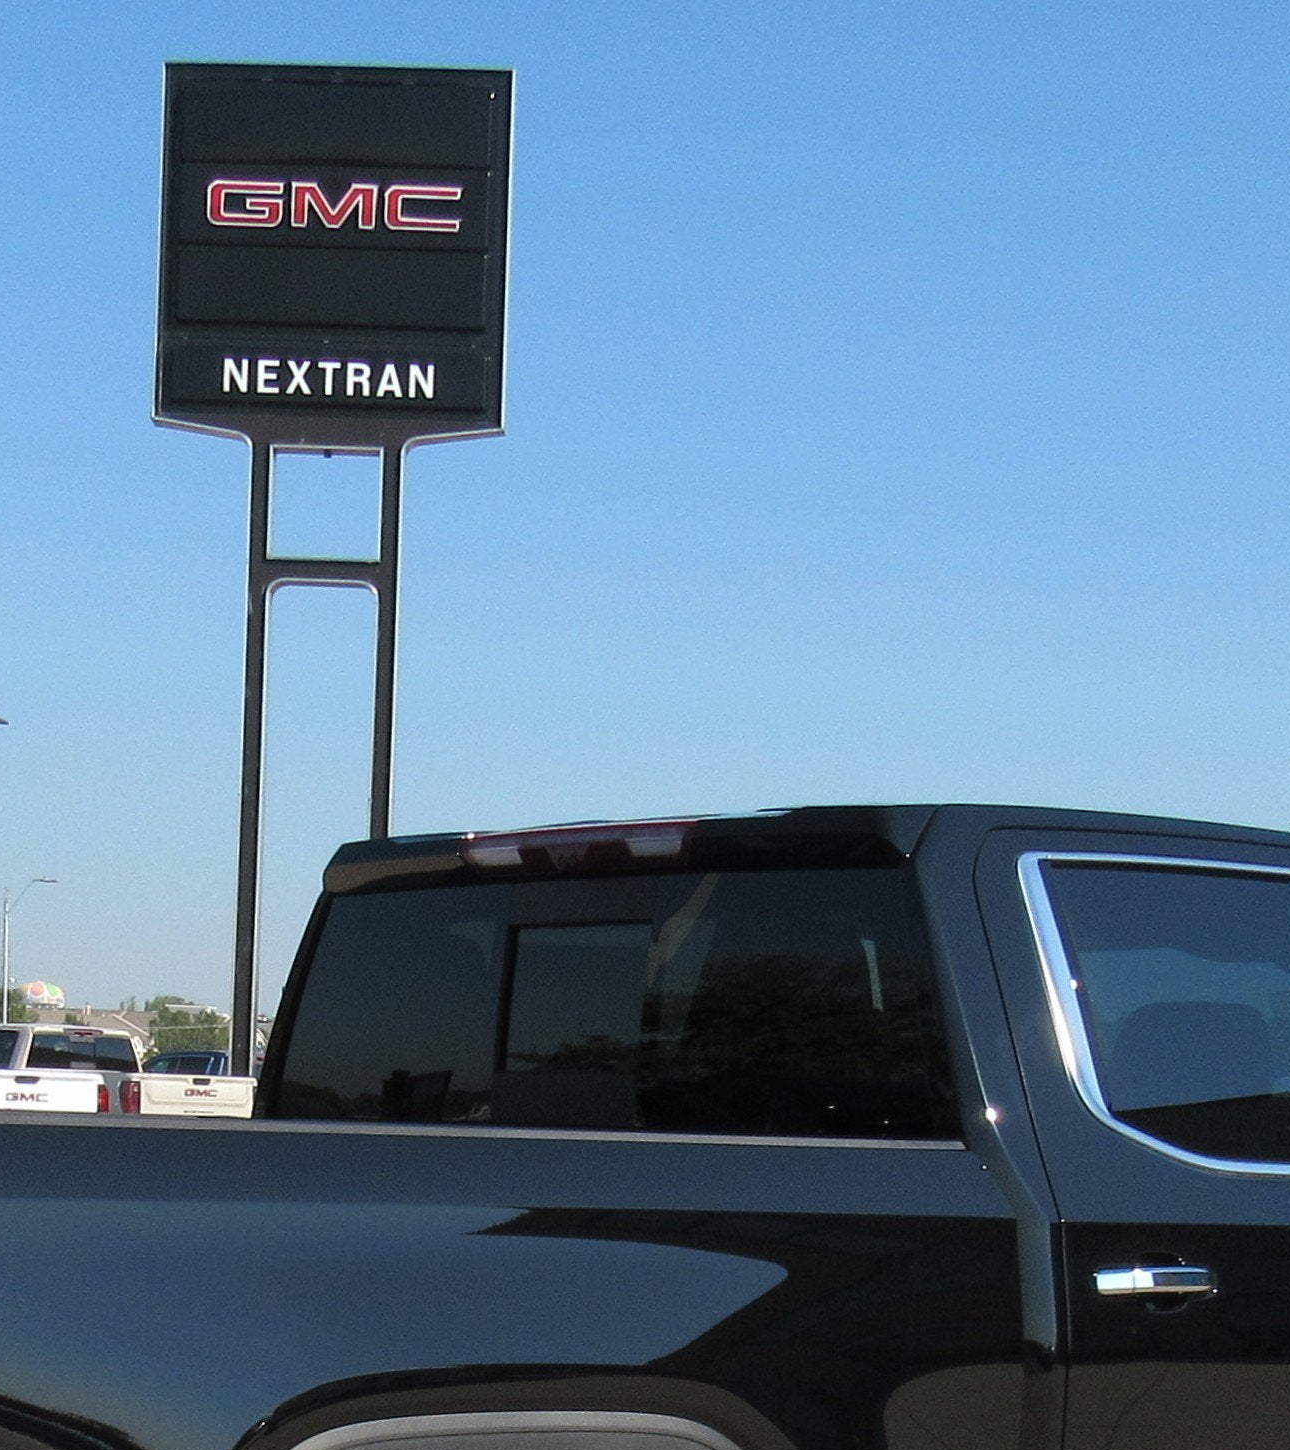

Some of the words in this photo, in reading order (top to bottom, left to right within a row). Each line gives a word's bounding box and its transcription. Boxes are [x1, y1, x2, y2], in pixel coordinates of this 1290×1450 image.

[207, 180, 463, 233] GMC
[221, 357, 436, 399] NEXTRAN
[6, 1092, 48, 1102] GMC
[184, 1089, 218, 1097] GMC
